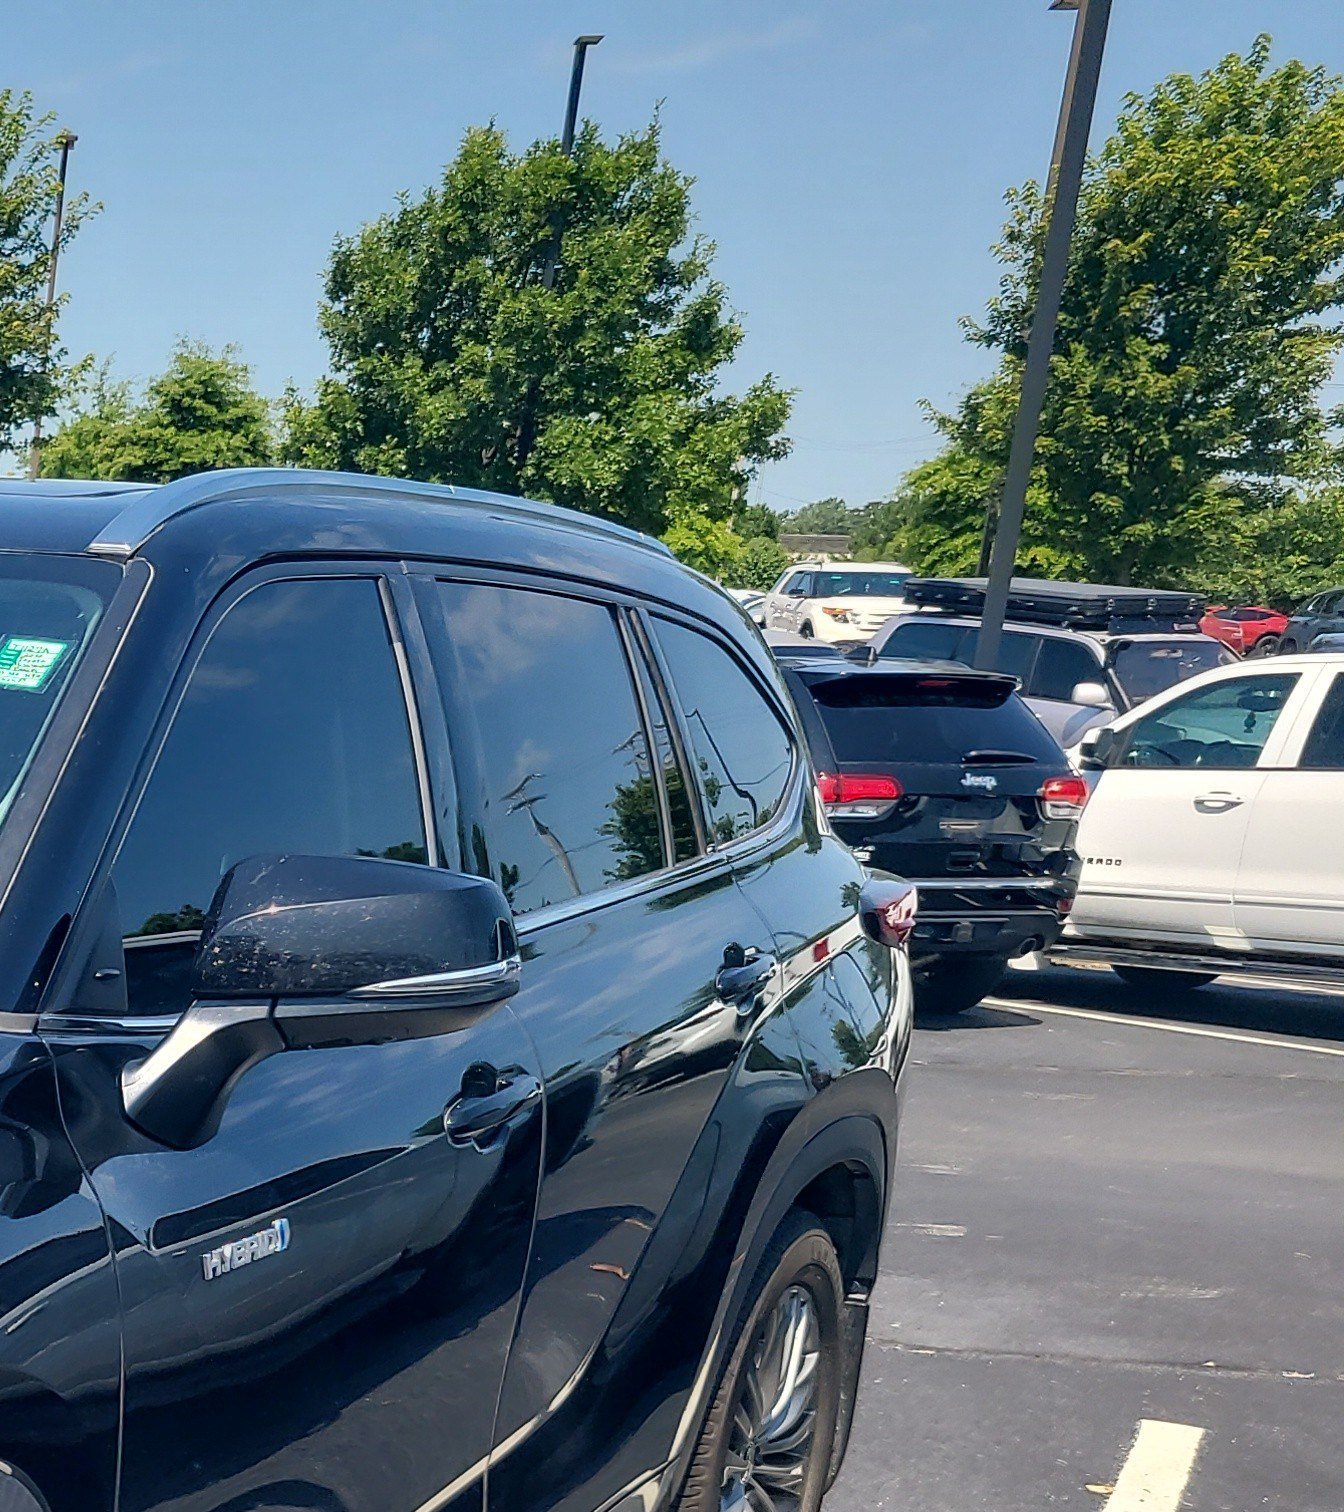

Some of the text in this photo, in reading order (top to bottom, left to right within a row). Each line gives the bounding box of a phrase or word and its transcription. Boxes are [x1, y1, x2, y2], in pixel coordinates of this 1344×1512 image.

[960, 772, 998, 791] Jeep
[1082, 857, 1122, 866] RADO
[201, 1218, 291, 1281] HYBRID
